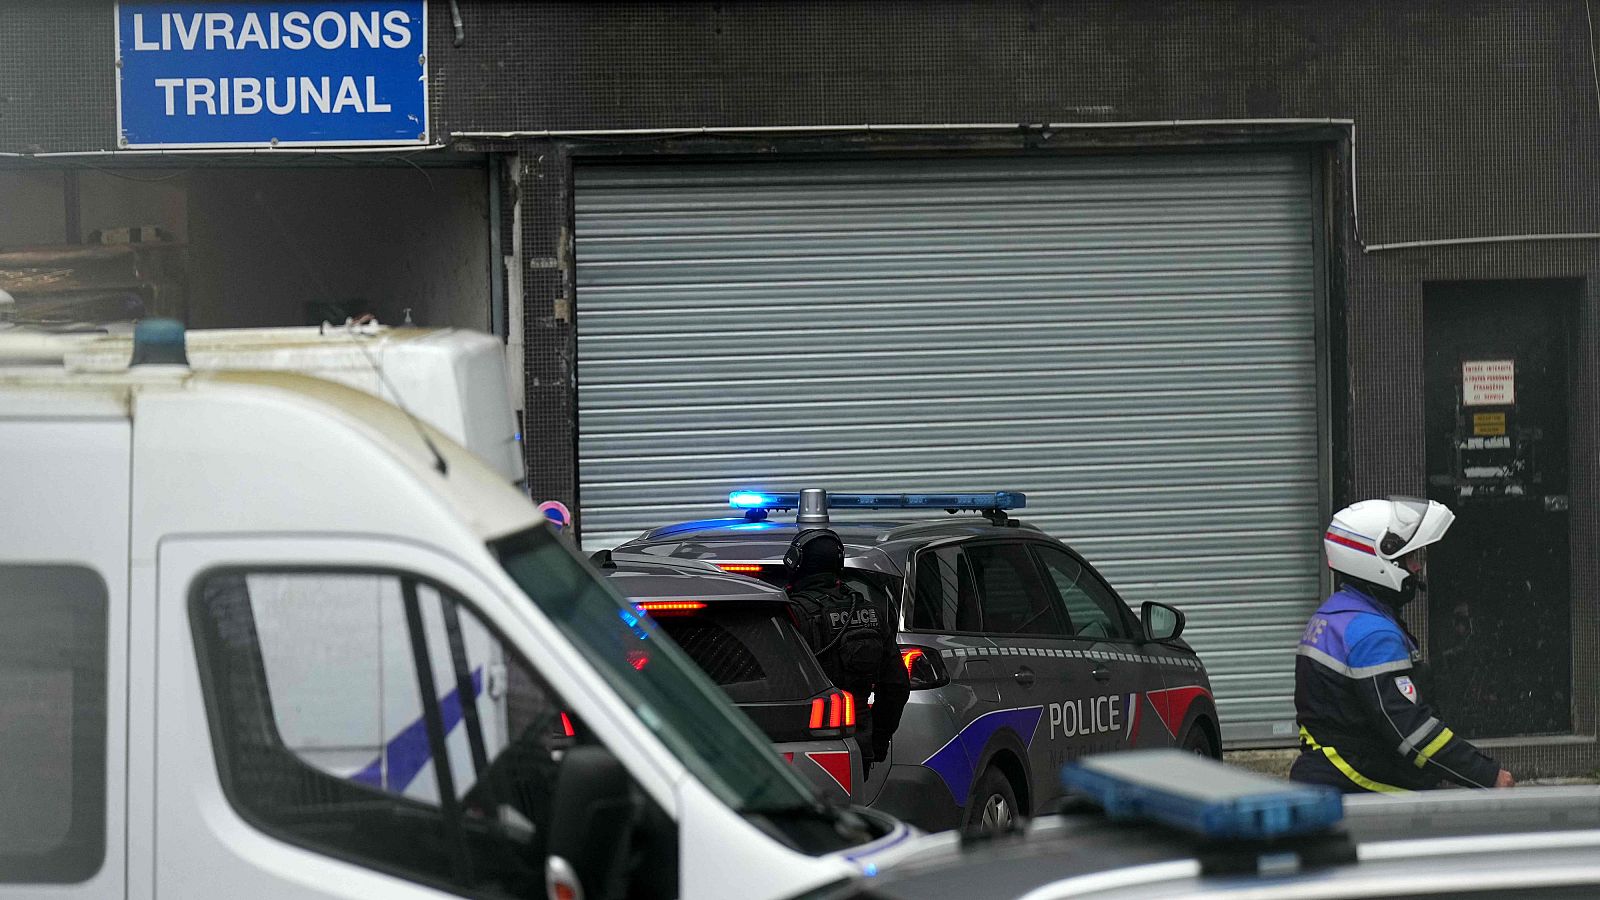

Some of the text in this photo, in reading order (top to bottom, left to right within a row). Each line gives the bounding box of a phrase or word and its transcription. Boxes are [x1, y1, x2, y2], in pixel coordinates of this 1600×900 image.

[133, 11, 412, 51] LIVRAISONS
[155, 75, 392, 116] TRIBUNAL
[829, 608, 878, 626] POLICE
[1049, 695, 1121, 740] POLICE
